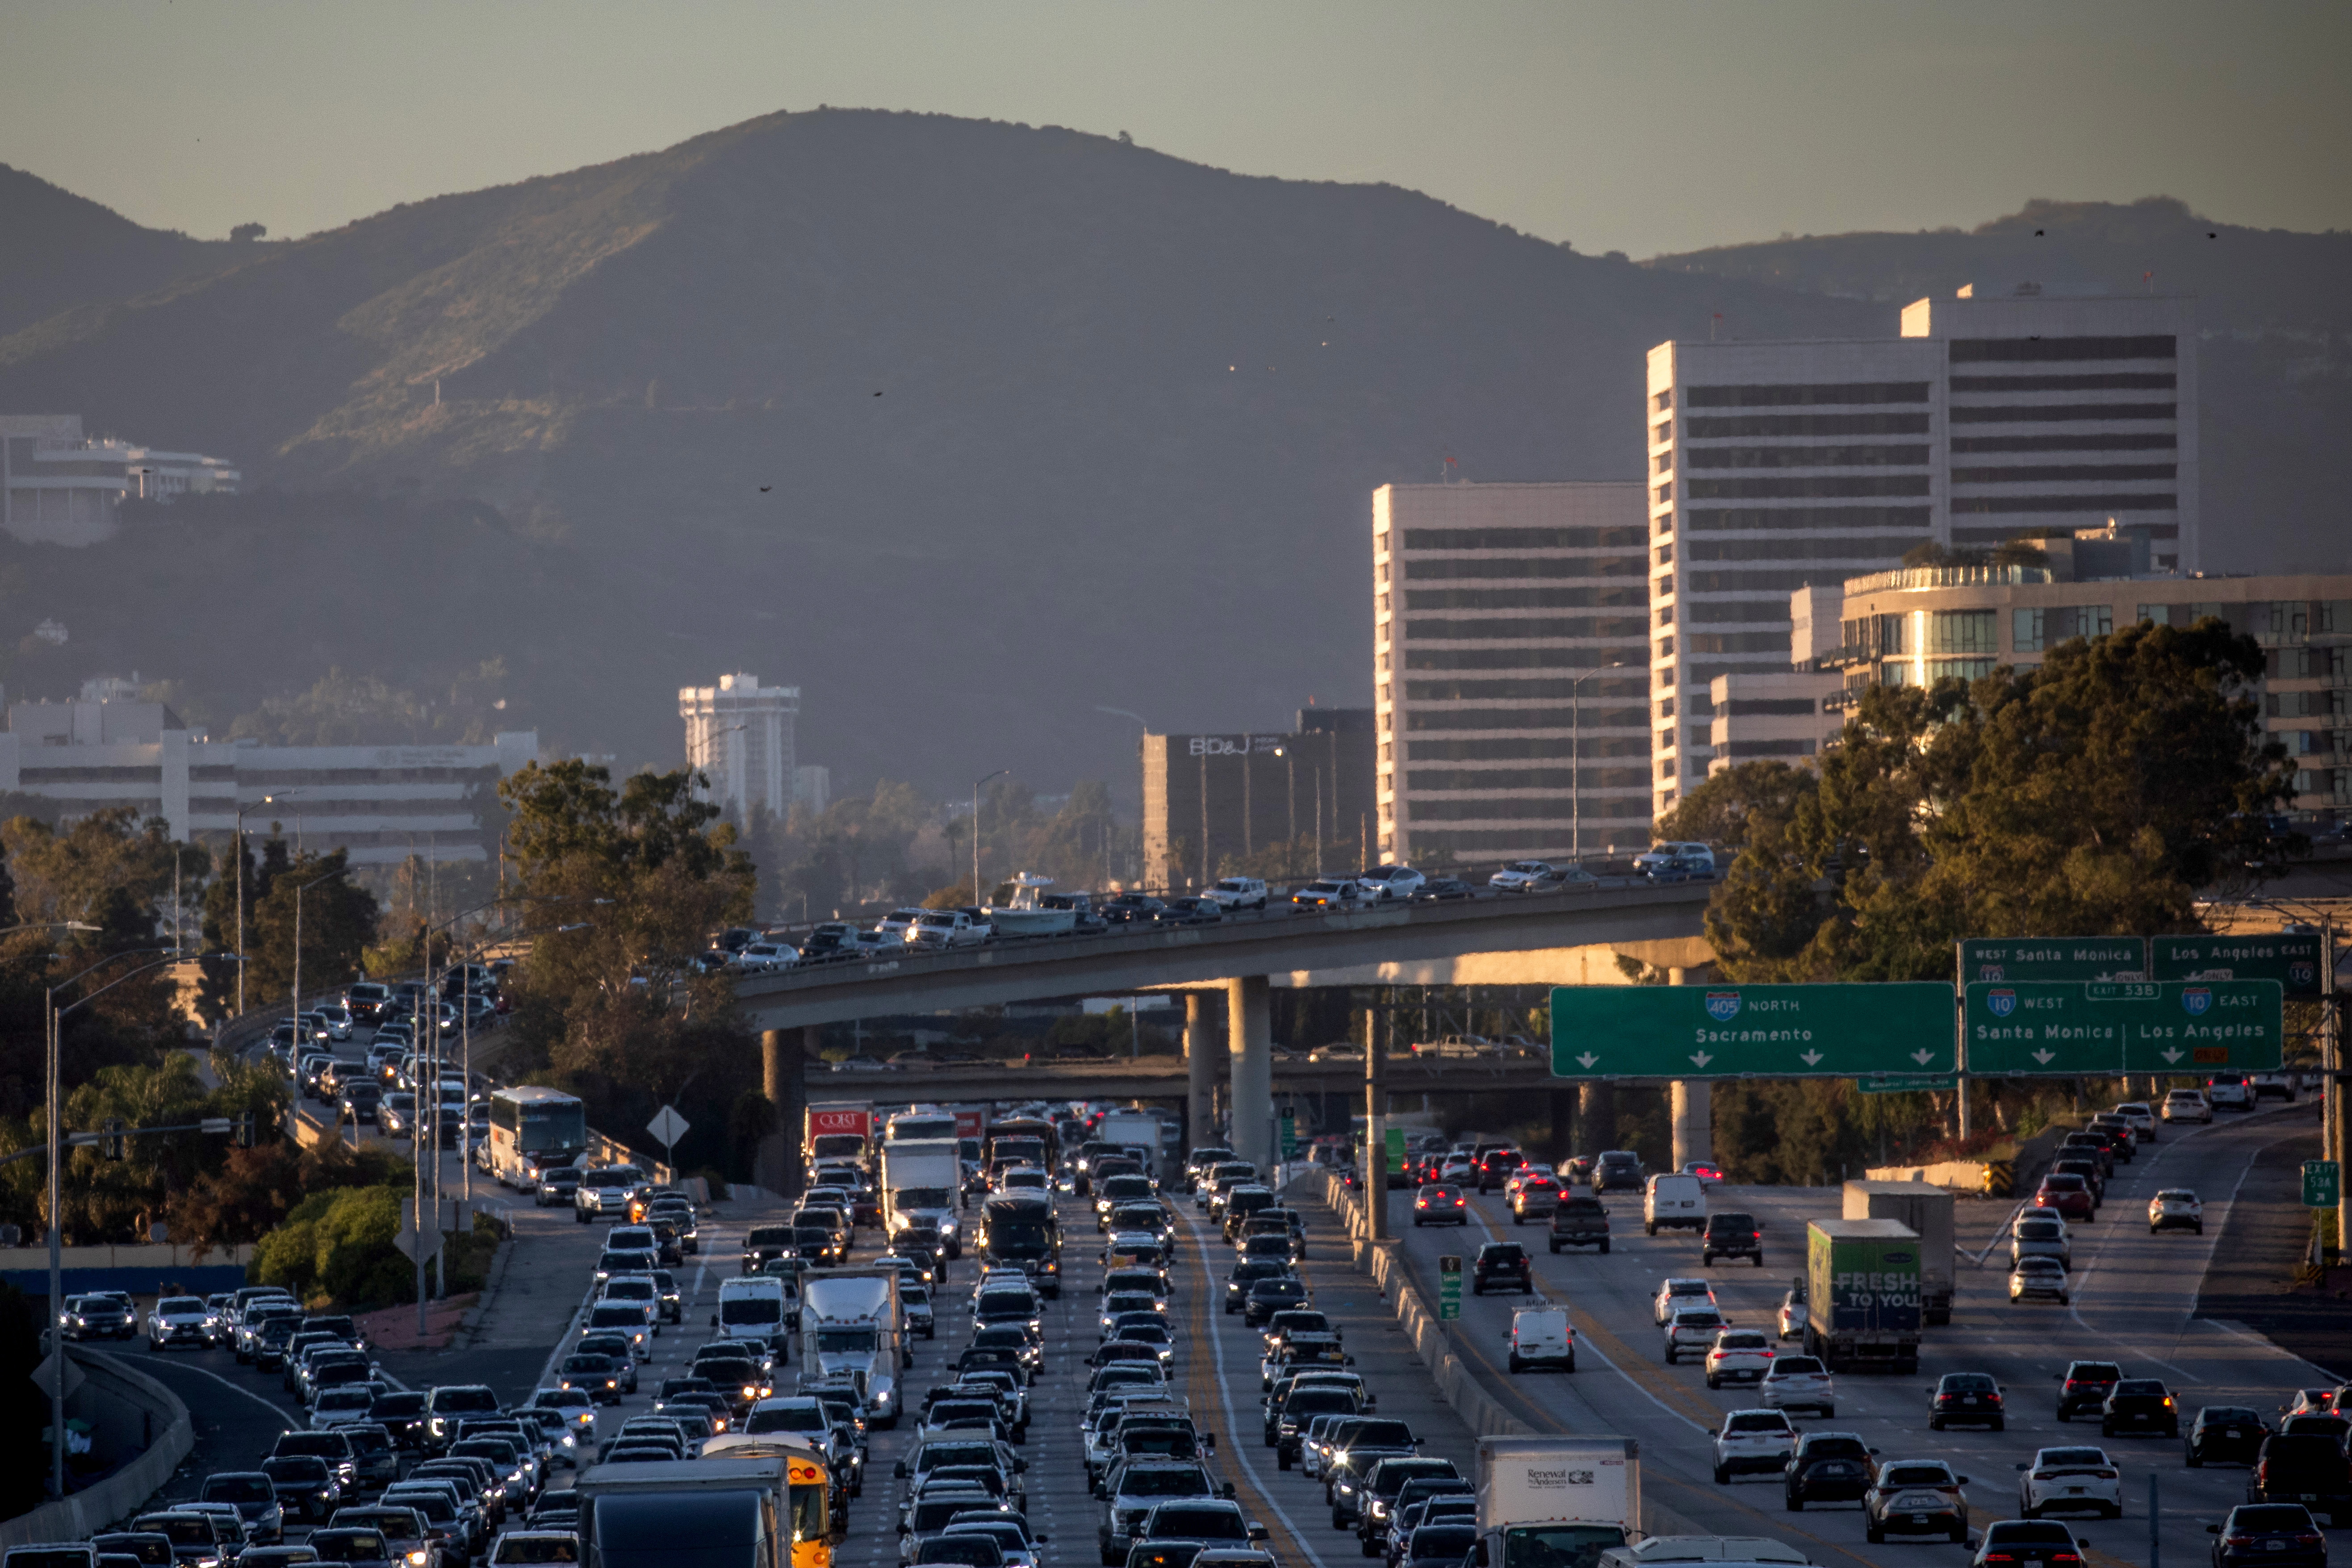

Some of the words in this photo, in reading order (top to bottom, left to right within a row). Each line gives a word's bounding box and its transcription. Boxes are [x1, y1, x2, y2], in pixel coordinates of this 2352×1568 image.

[1189, 737, 1249, 755] BD&J
[1975, 949, 2007, 959] WEST
[2016, 949, 2061, 961] Santa
[2074, 949, 2131, 961] Monica
[2172, 947, 2199, 960] Los
[2211, 945, 2274, 962] Angeles
[2281, 945, 2311, 955] EAST
[2117, 974, 2141, 982] ONLY
[2206, 971, 2231, 981] ONLY
[2295, 970, 2311, 981] 10
[2093, 986, 2116, 995] EXIT
[1709, 1000, 1737, 1014] 405
[1749, 1000, 1800, 1011] NORTH
[1995, 998, 2010, 1012] 10
[2024, 997, 2064, 1009] WEST
[2189, 996, 2205, 1009] 10
[2220, 995, 2258, 1006] EAST
[1696, 1028, 1812, 1043] Sacramento
[1977, 1025, 2034, 1039] Santa
[2046, 1024, 2113, 1039] Monica
[2141, 1024, 2173, 1038] Los
[2185, 1024, 2264, 1041] Angeles
[819, 1113, 858, 1125] CORT
[2306, 1164, 2335, 1174] EXIT
[1838, 1272, 1916, 1291] FRESH
[1848, 1292, 1874, 1307] TO
[1879, 1293, 1919, 1308] YOU
[1528, 1469, 1566, 1478] Renewal
